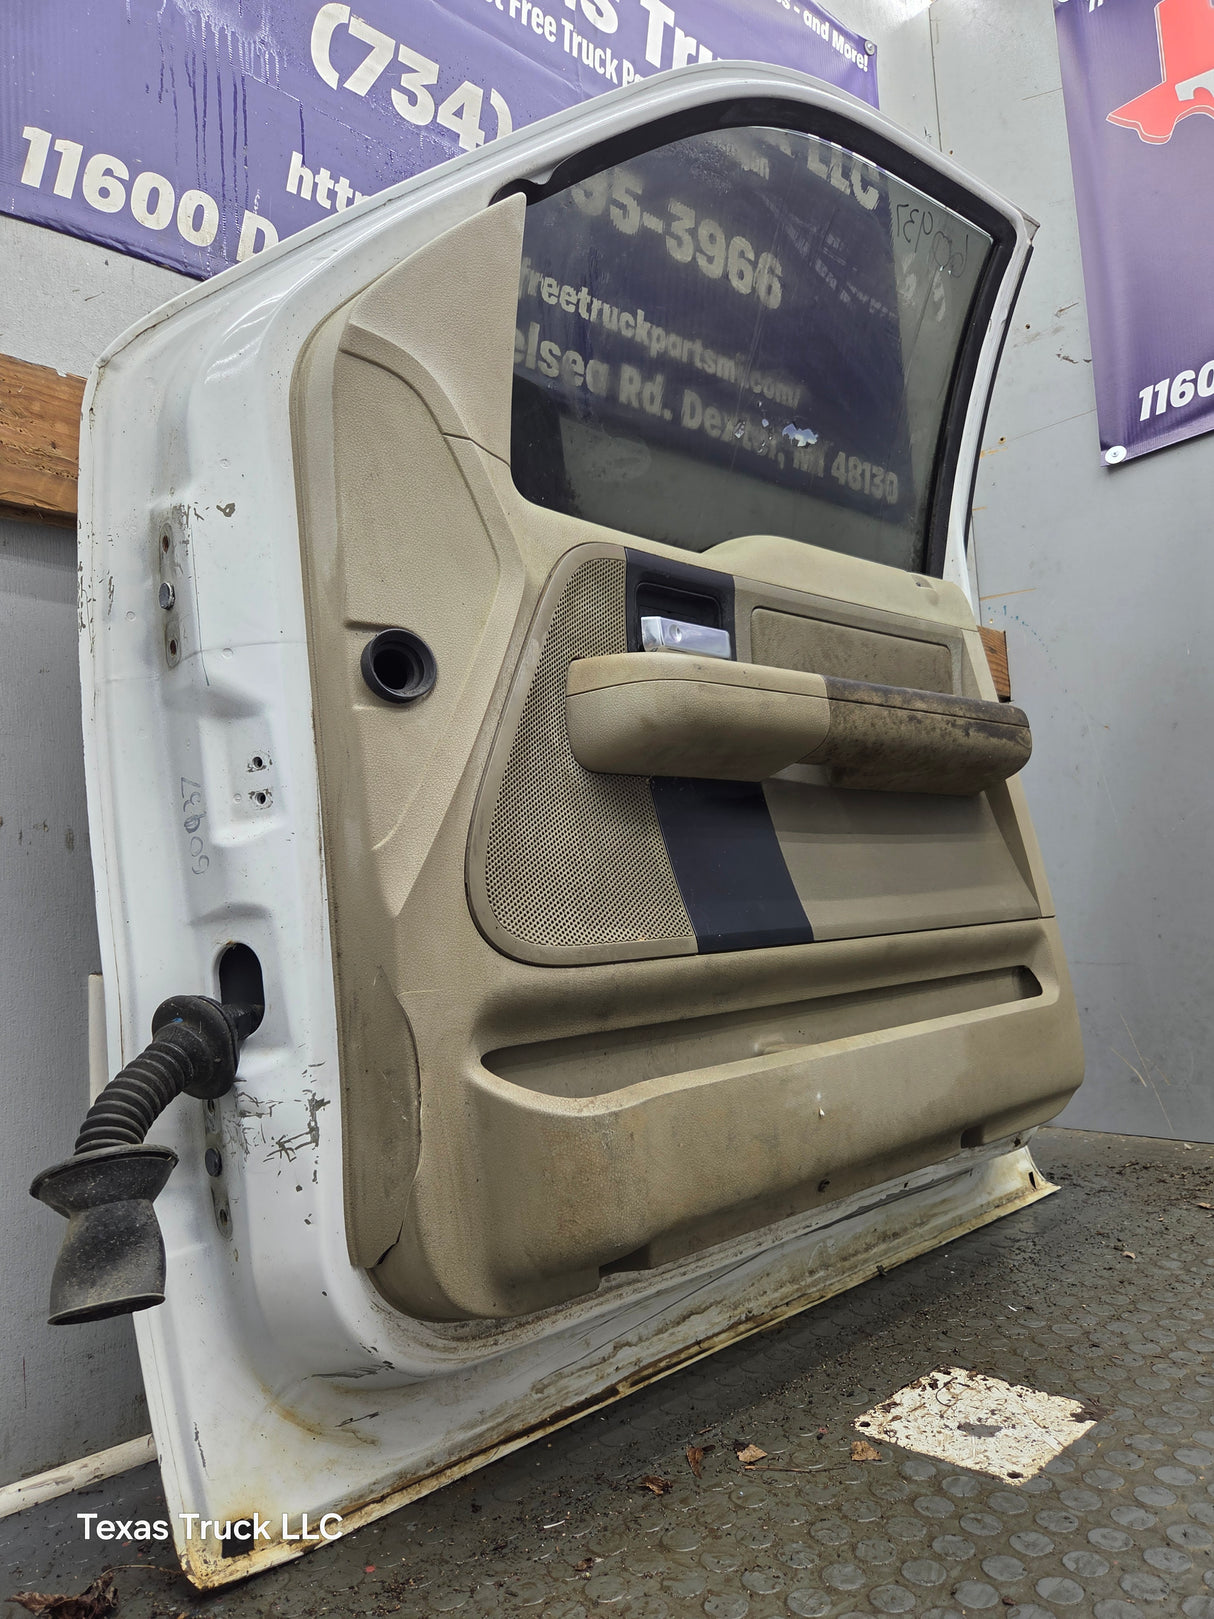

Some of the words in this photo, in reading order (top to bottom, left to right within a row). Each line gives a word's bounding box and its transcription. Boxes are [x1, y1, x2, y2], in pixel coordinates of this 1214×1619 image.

[561, 17, 618, 84] Truck
[640, 0, 723, 69] Tr
[803, 10, 830, 41] and
[832, 30, 869, 72] More!
[311, 2, 513, 151] (734)
[22, 126, 219, 247] 11600
[286, 150, 371, 213] htt
[619, 363, 673, 419] Rd.
[831, 451, 899, 504] 48130
